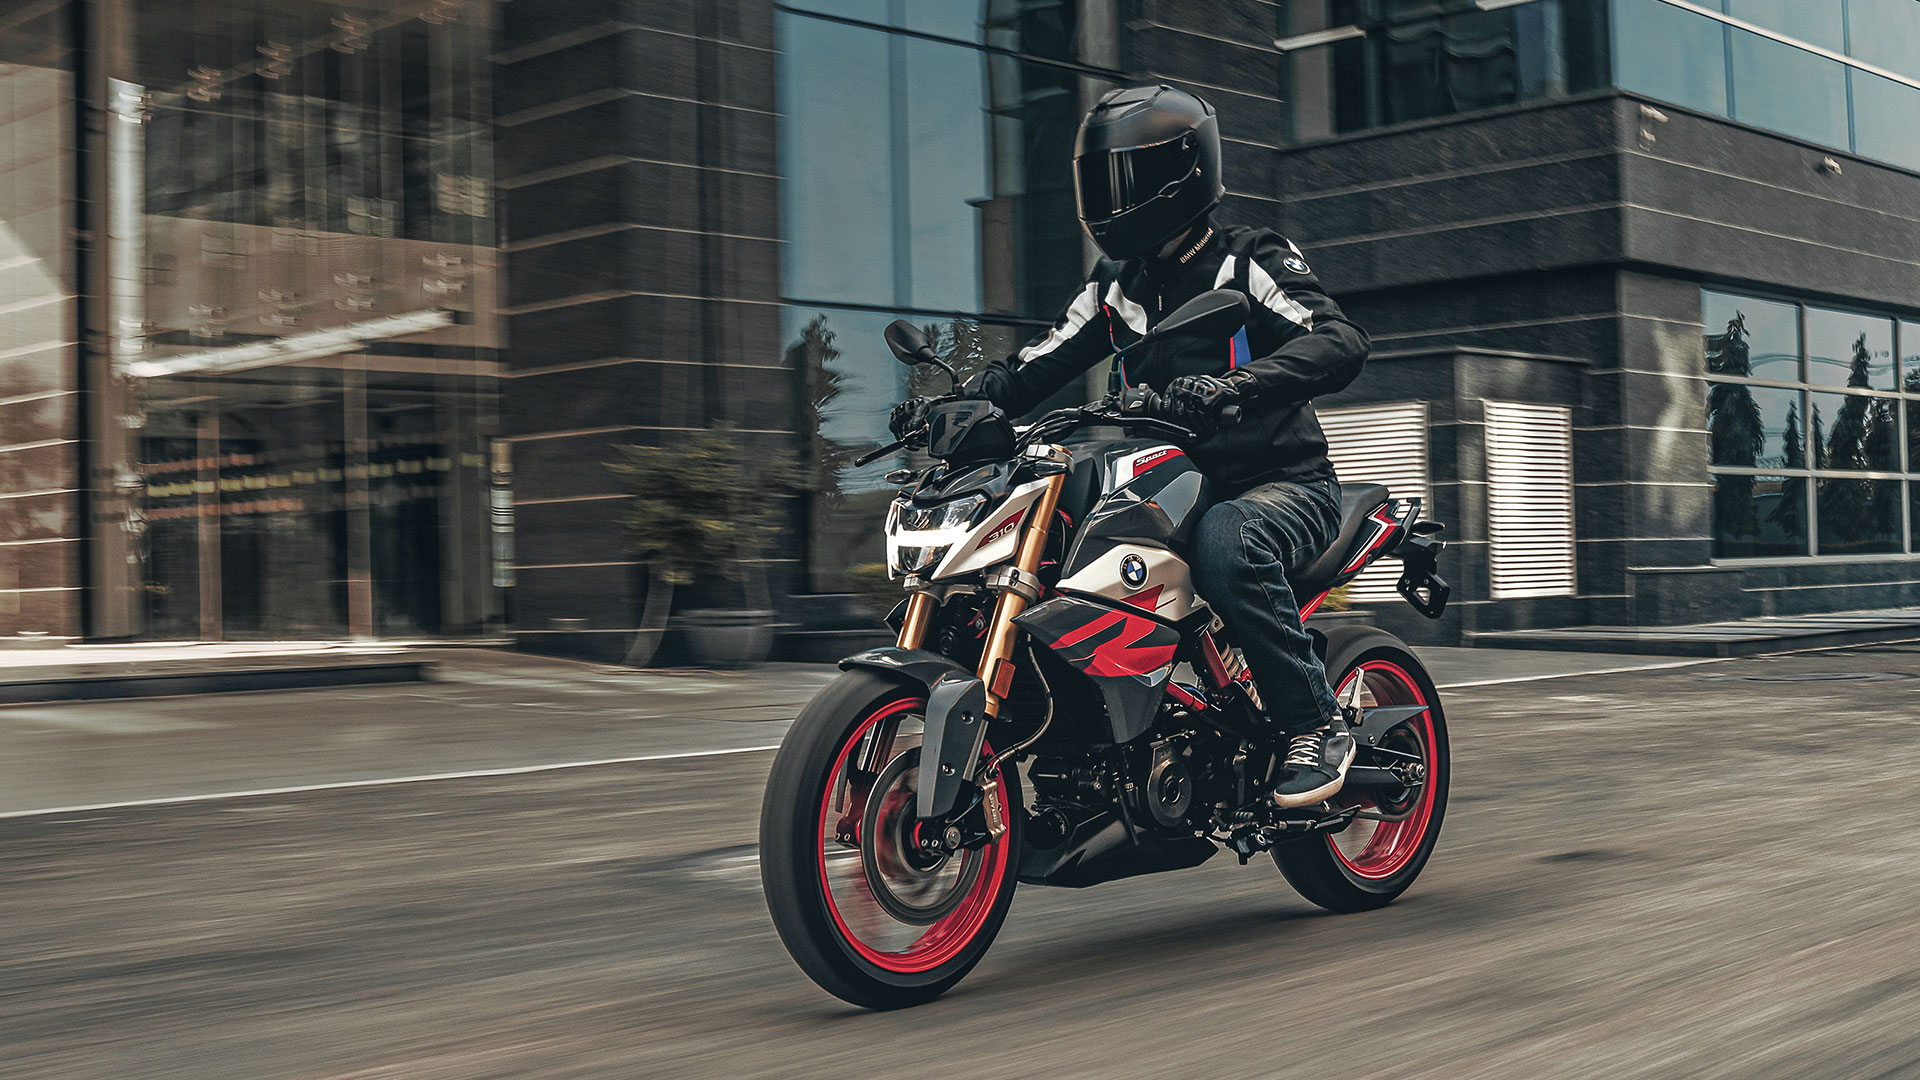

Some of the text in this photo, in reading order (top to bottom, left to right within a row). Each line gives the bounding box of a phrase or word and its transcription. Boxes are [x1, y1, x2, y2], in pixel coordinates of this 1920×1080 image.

[1180, 248, 1196, 264] BMW
[1135, 450, 1168, 466] Sport
[988, 522, 1014, 543] 310
